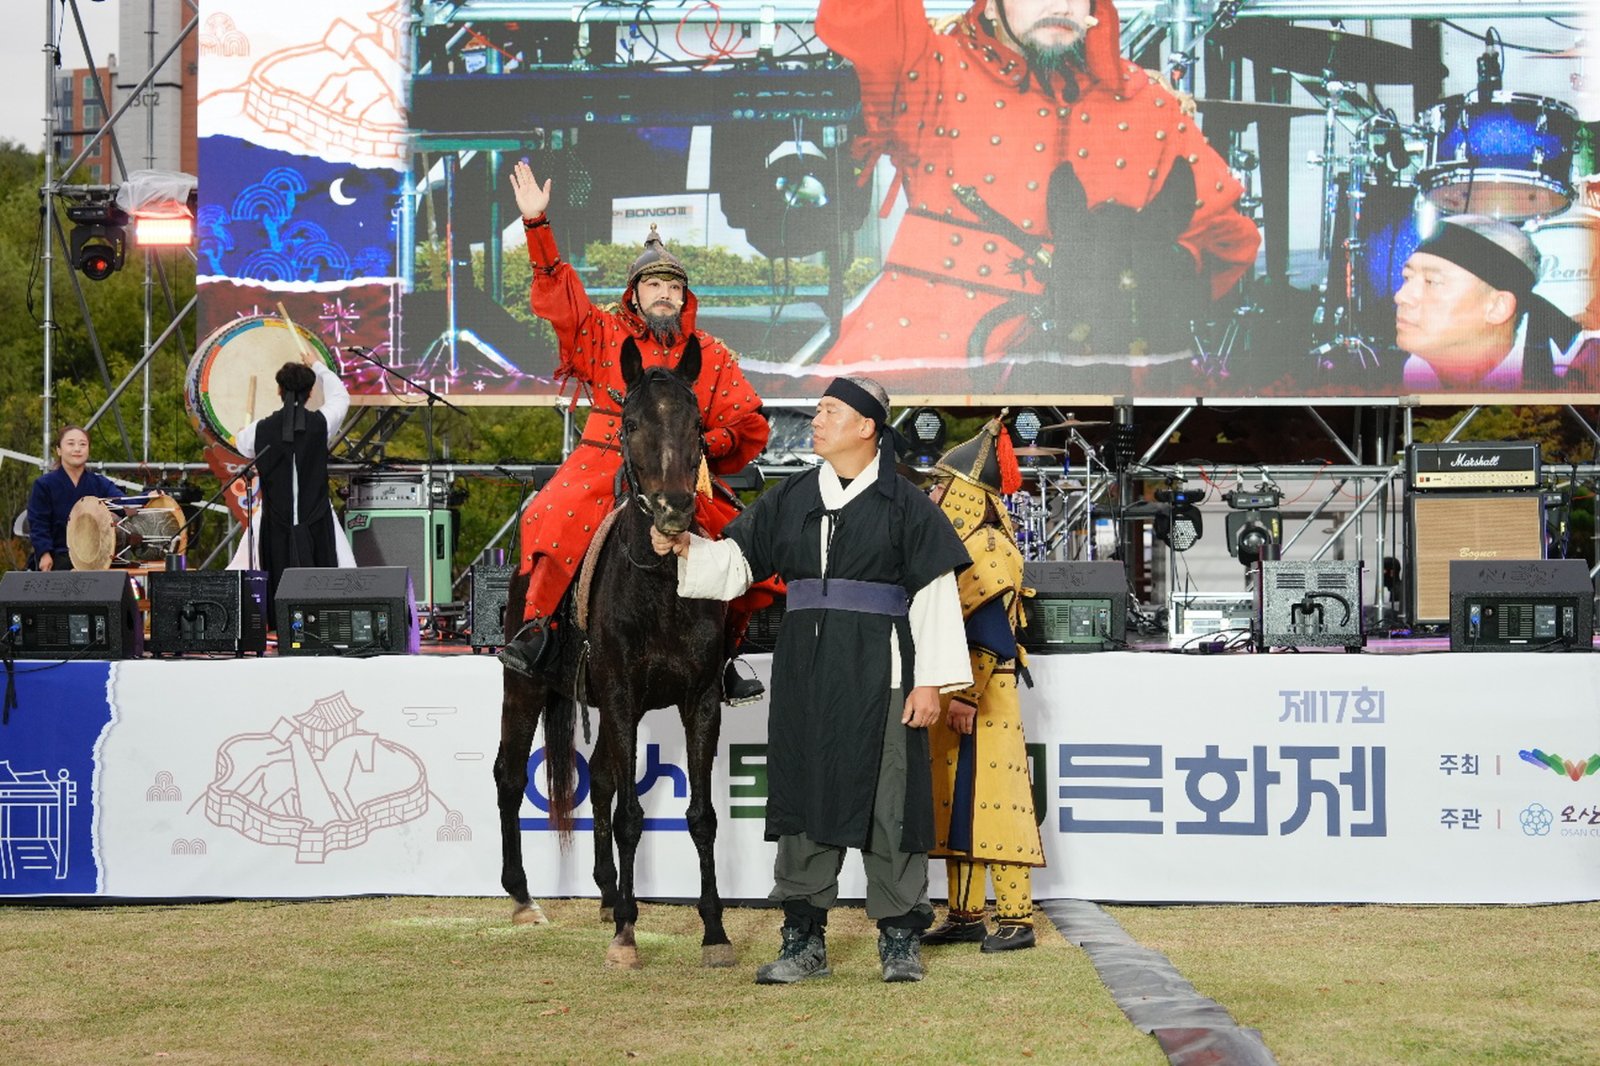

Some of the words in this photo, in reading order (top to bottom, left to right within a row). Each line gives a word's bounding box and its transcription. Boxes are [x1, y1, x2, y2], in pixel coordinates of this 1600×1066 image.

[625, 207, 676, 218] BONGO
[1540, 255, 1592, 278] Pear
[1450, 453, 1500, 468] Marshall
[1459, 547, 1497, 560] Bogner
[1279, 686, 1385, 724] 제17회
[1439, 753, 1479, 776] 주최
[1440, 808, 1482, 830] 주관
[1561, 828, 1588, 838] OSAN
